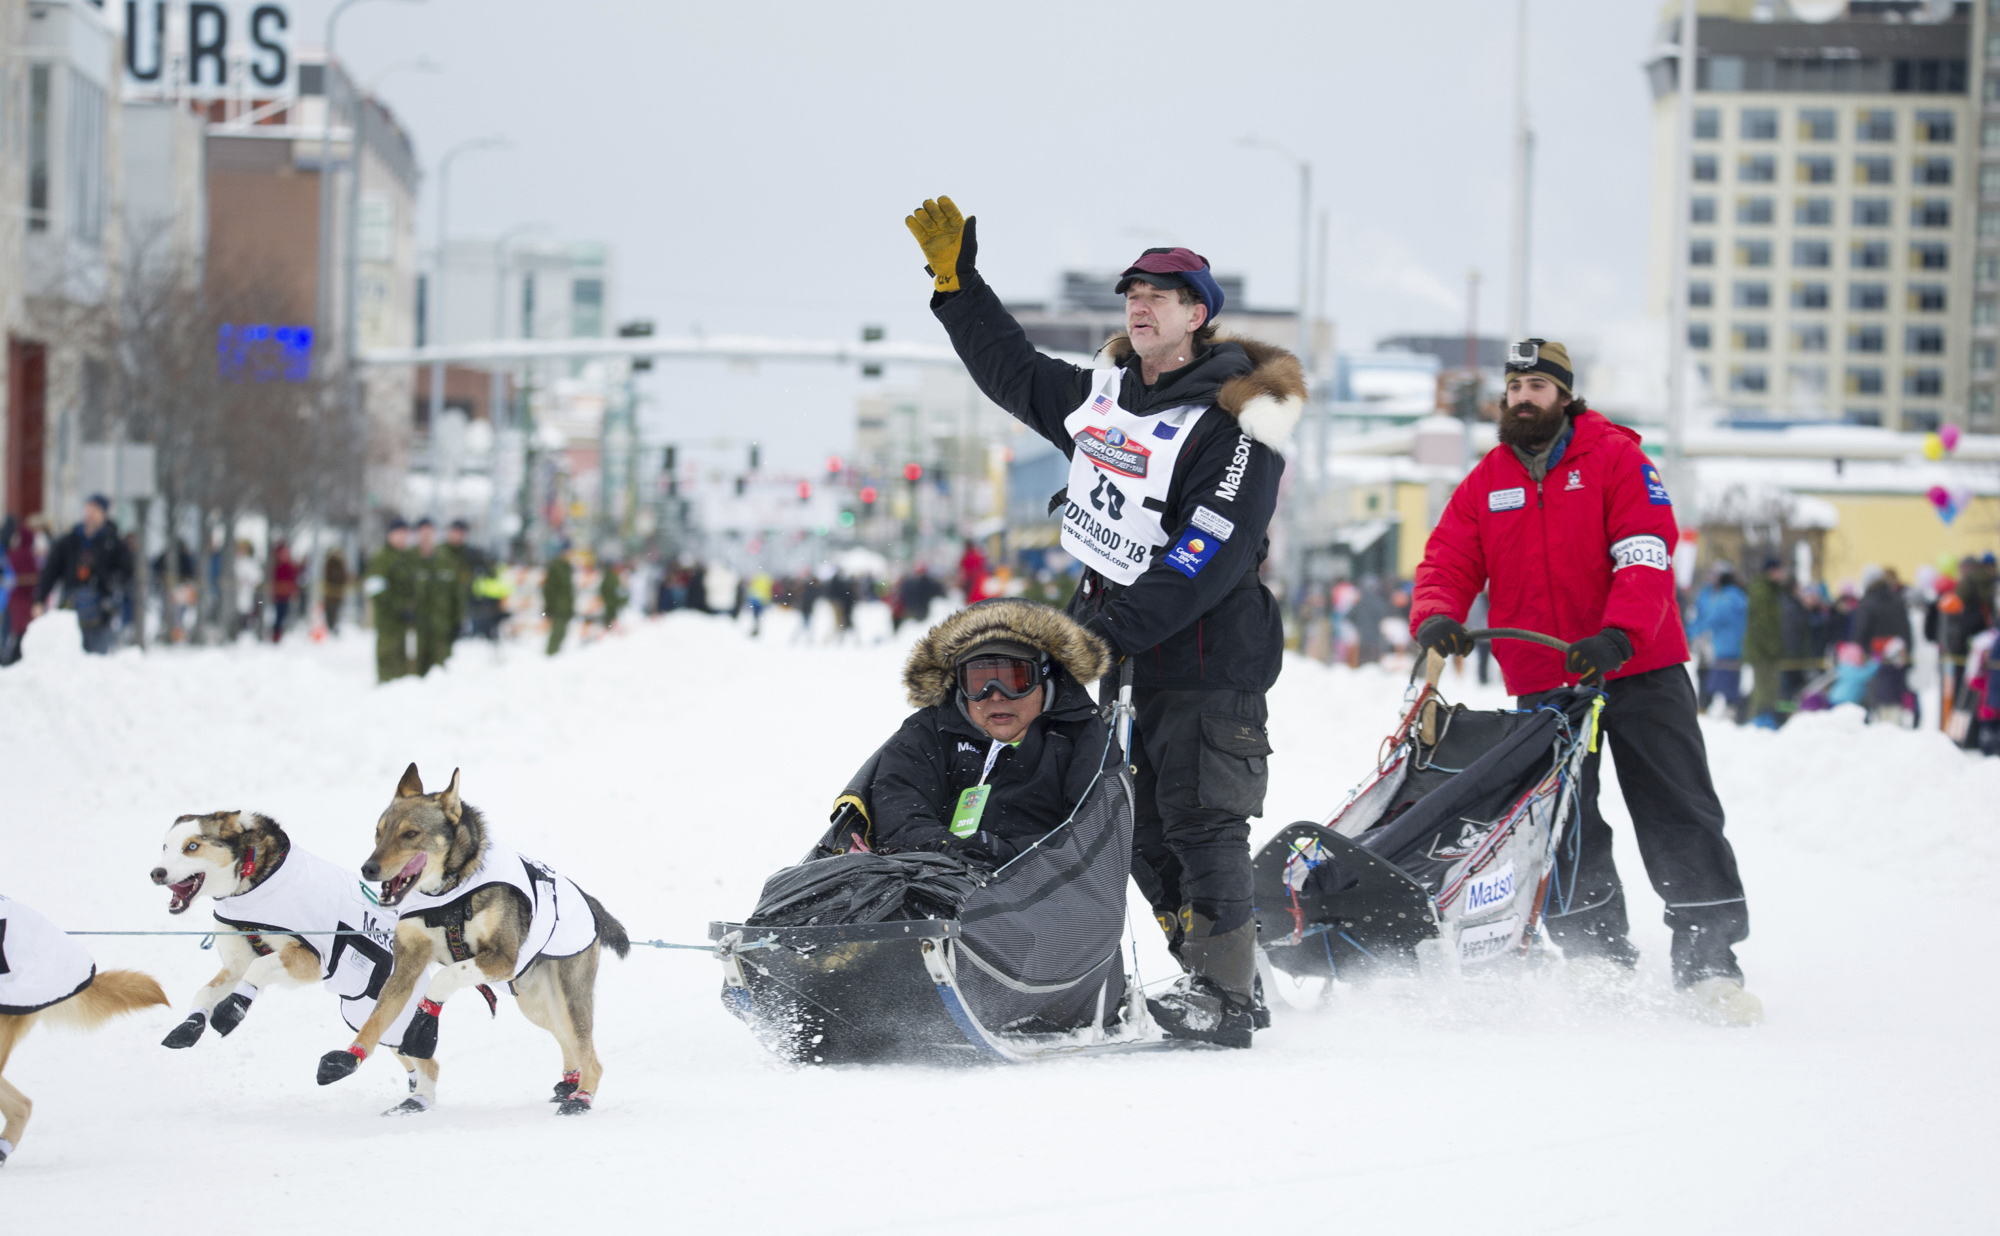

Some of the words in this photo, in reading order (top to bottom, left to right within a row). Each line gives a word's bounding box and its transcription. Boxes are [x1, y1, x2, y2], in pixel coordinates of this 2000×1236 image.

[92, 0, 287, 86] URS
[1215, 433, 1252, 502] Matson
[1065, 501, 1121, 550] DITAROD
[1124, 539, 1146, 563] '18
[1176, 547, 1202, 564] Comfort
[1624, 549, 1664, 566] 2018
